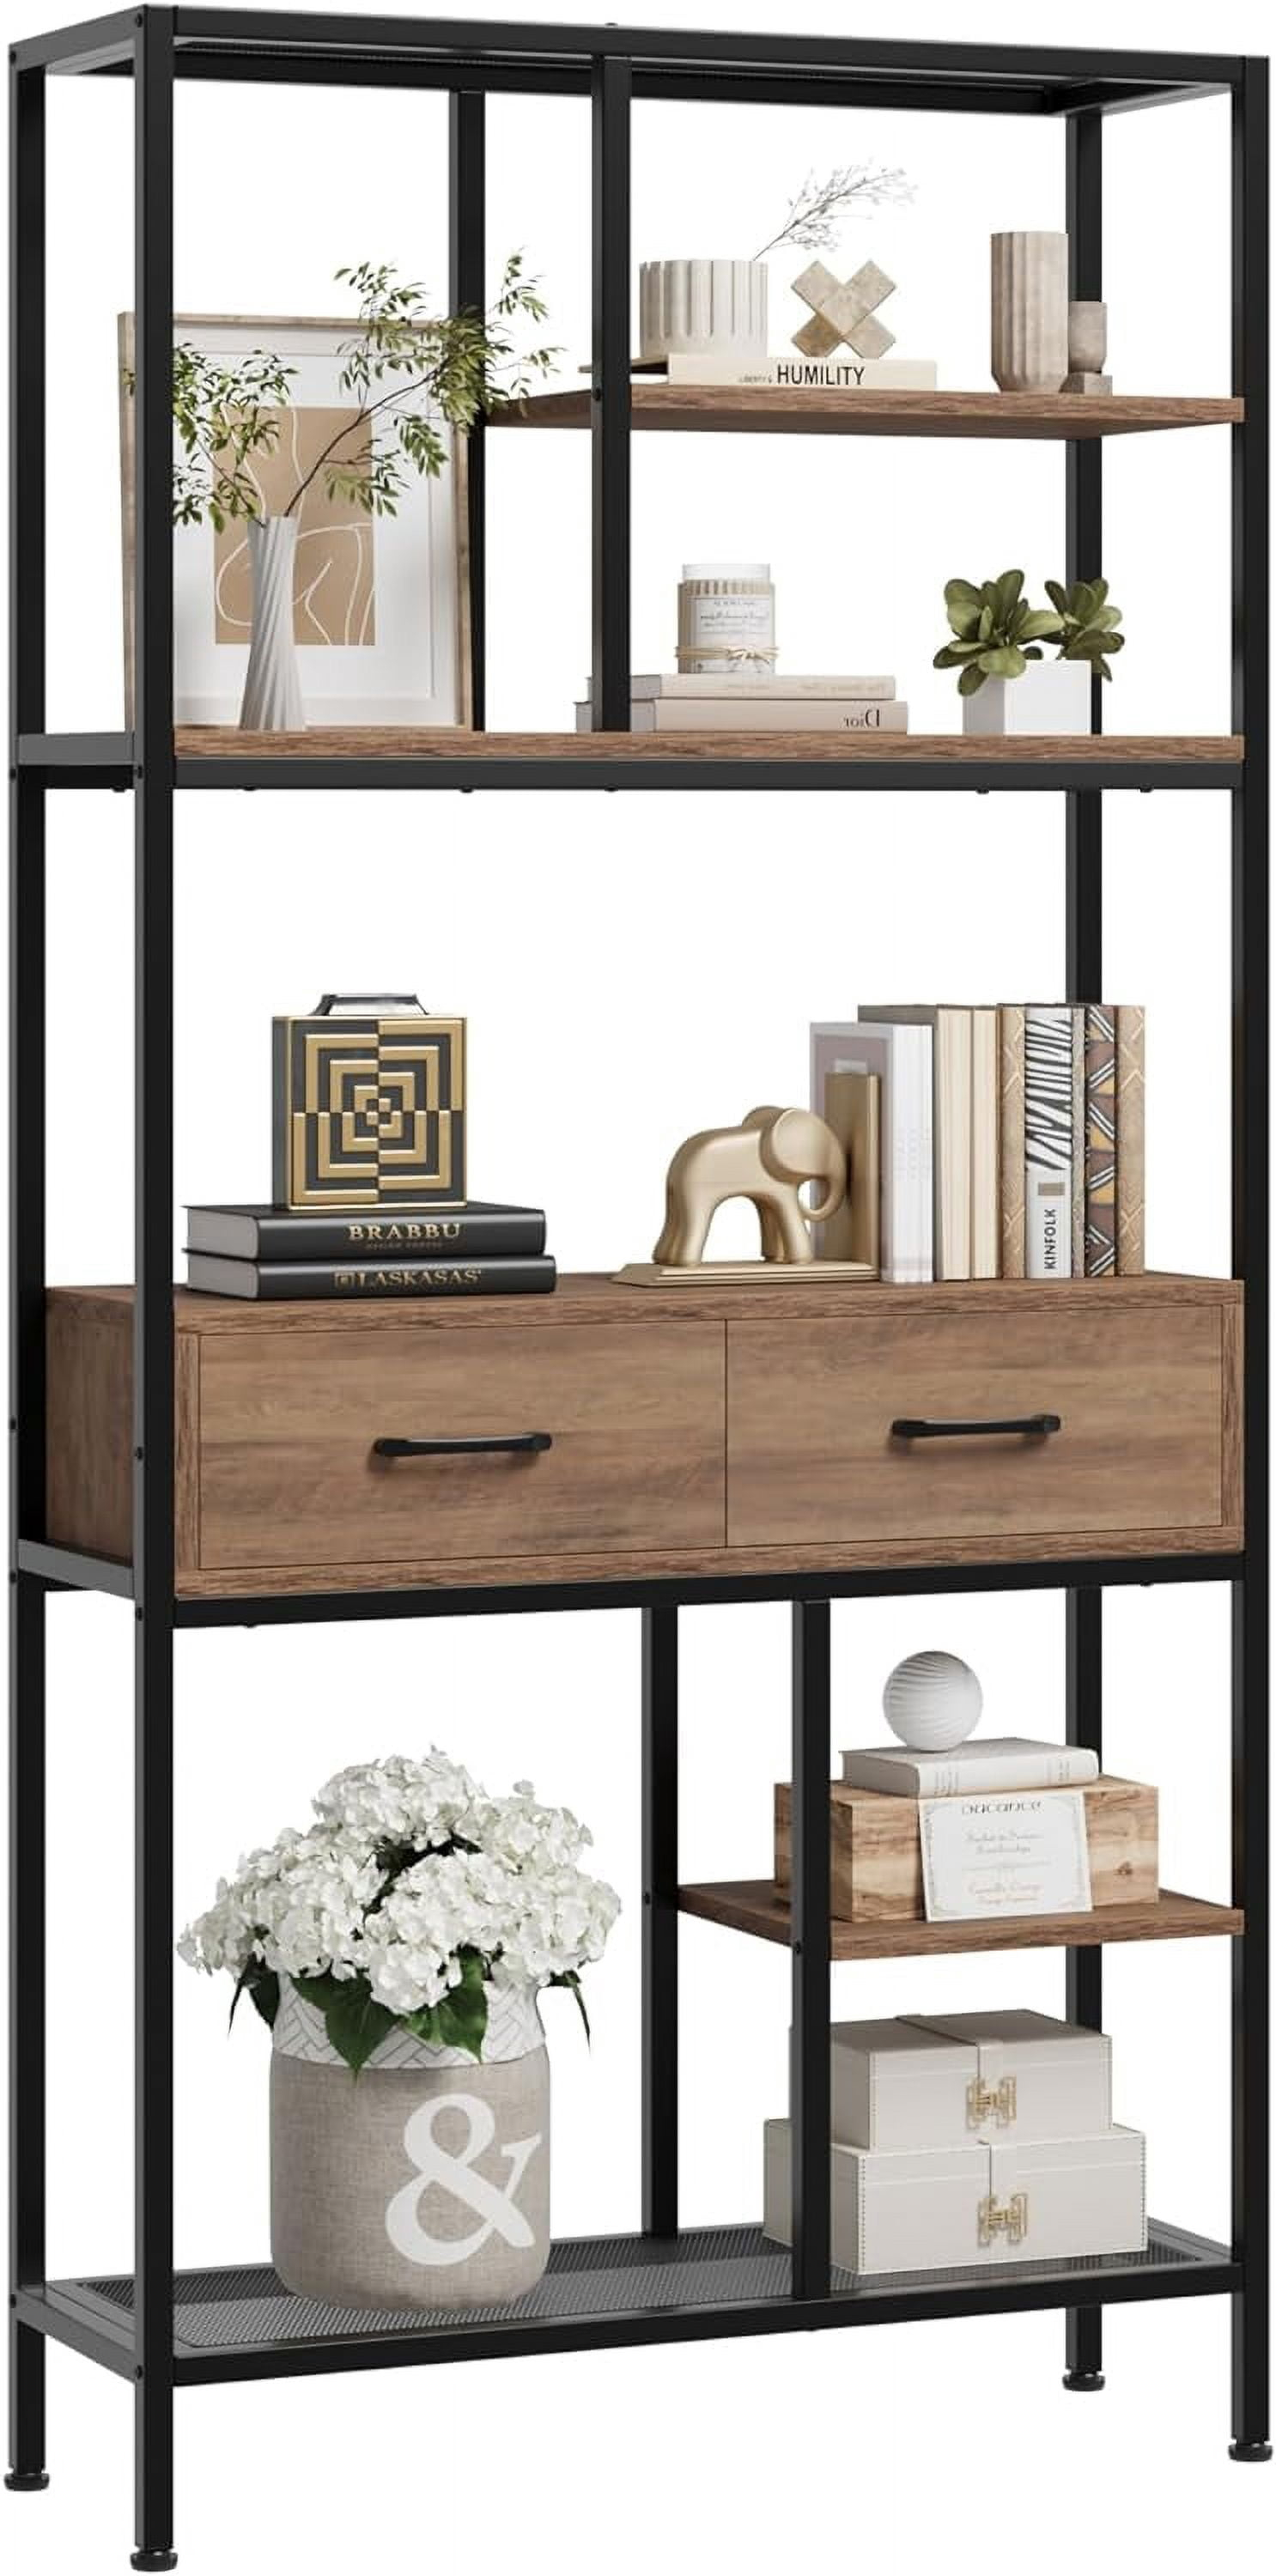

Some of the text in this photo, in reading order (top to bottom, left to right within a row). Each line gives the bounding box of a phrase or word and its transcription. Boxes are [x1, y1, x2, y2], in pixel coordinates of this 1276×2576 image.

[777, 364, 865, 385] HUMILITY
[349, 1223, 460, 1240] BRABBU
[1044, 1209, 1057, 1270] KINFOLK
[386, 2093, 543, 2265] &
